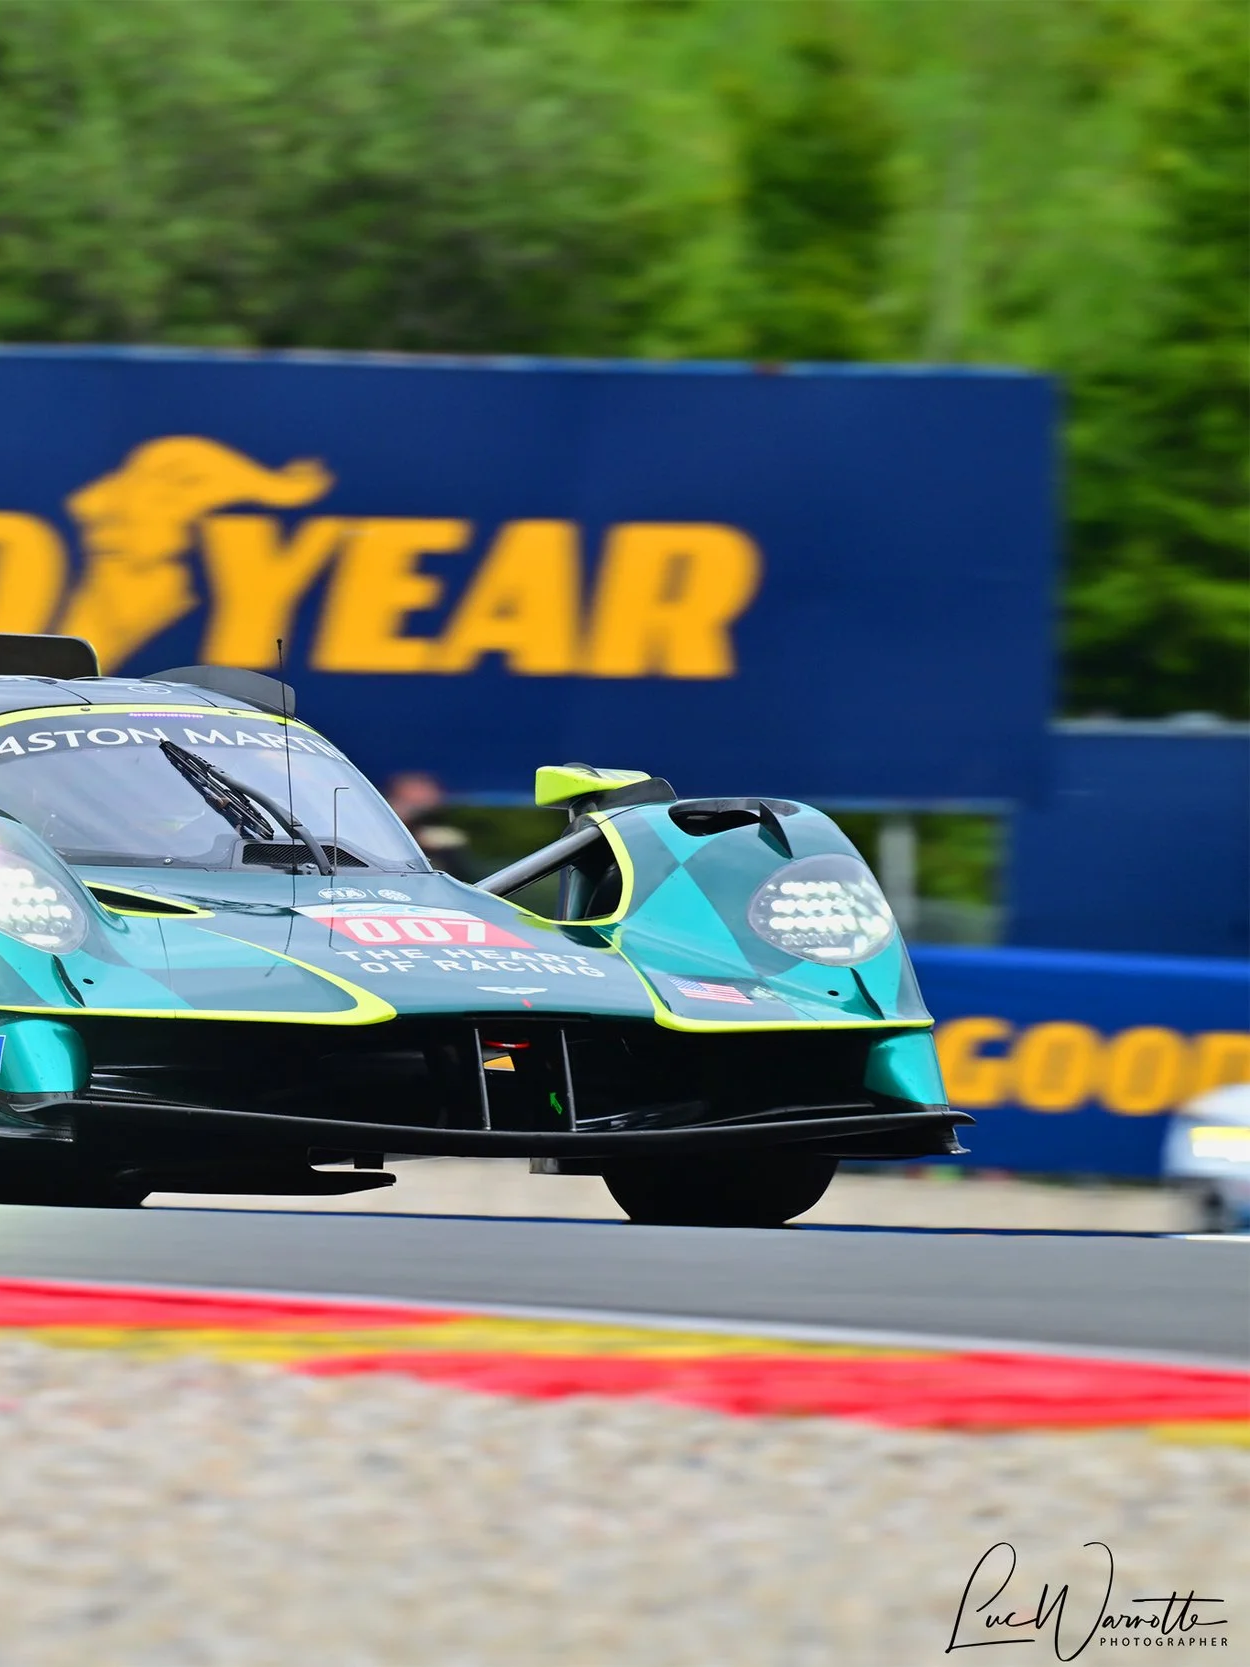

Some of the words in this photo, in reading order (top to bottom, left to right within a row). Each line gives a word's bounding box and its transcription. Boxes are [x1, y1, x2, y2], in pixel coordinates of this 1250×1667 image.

[344, 918, 486, 943] 007
[335, 949, 430, 962] THE
[442, 949, 590, 965] HEART
[360, 961, 416, 973] OF
[432, 960, 607, 978] RACING
